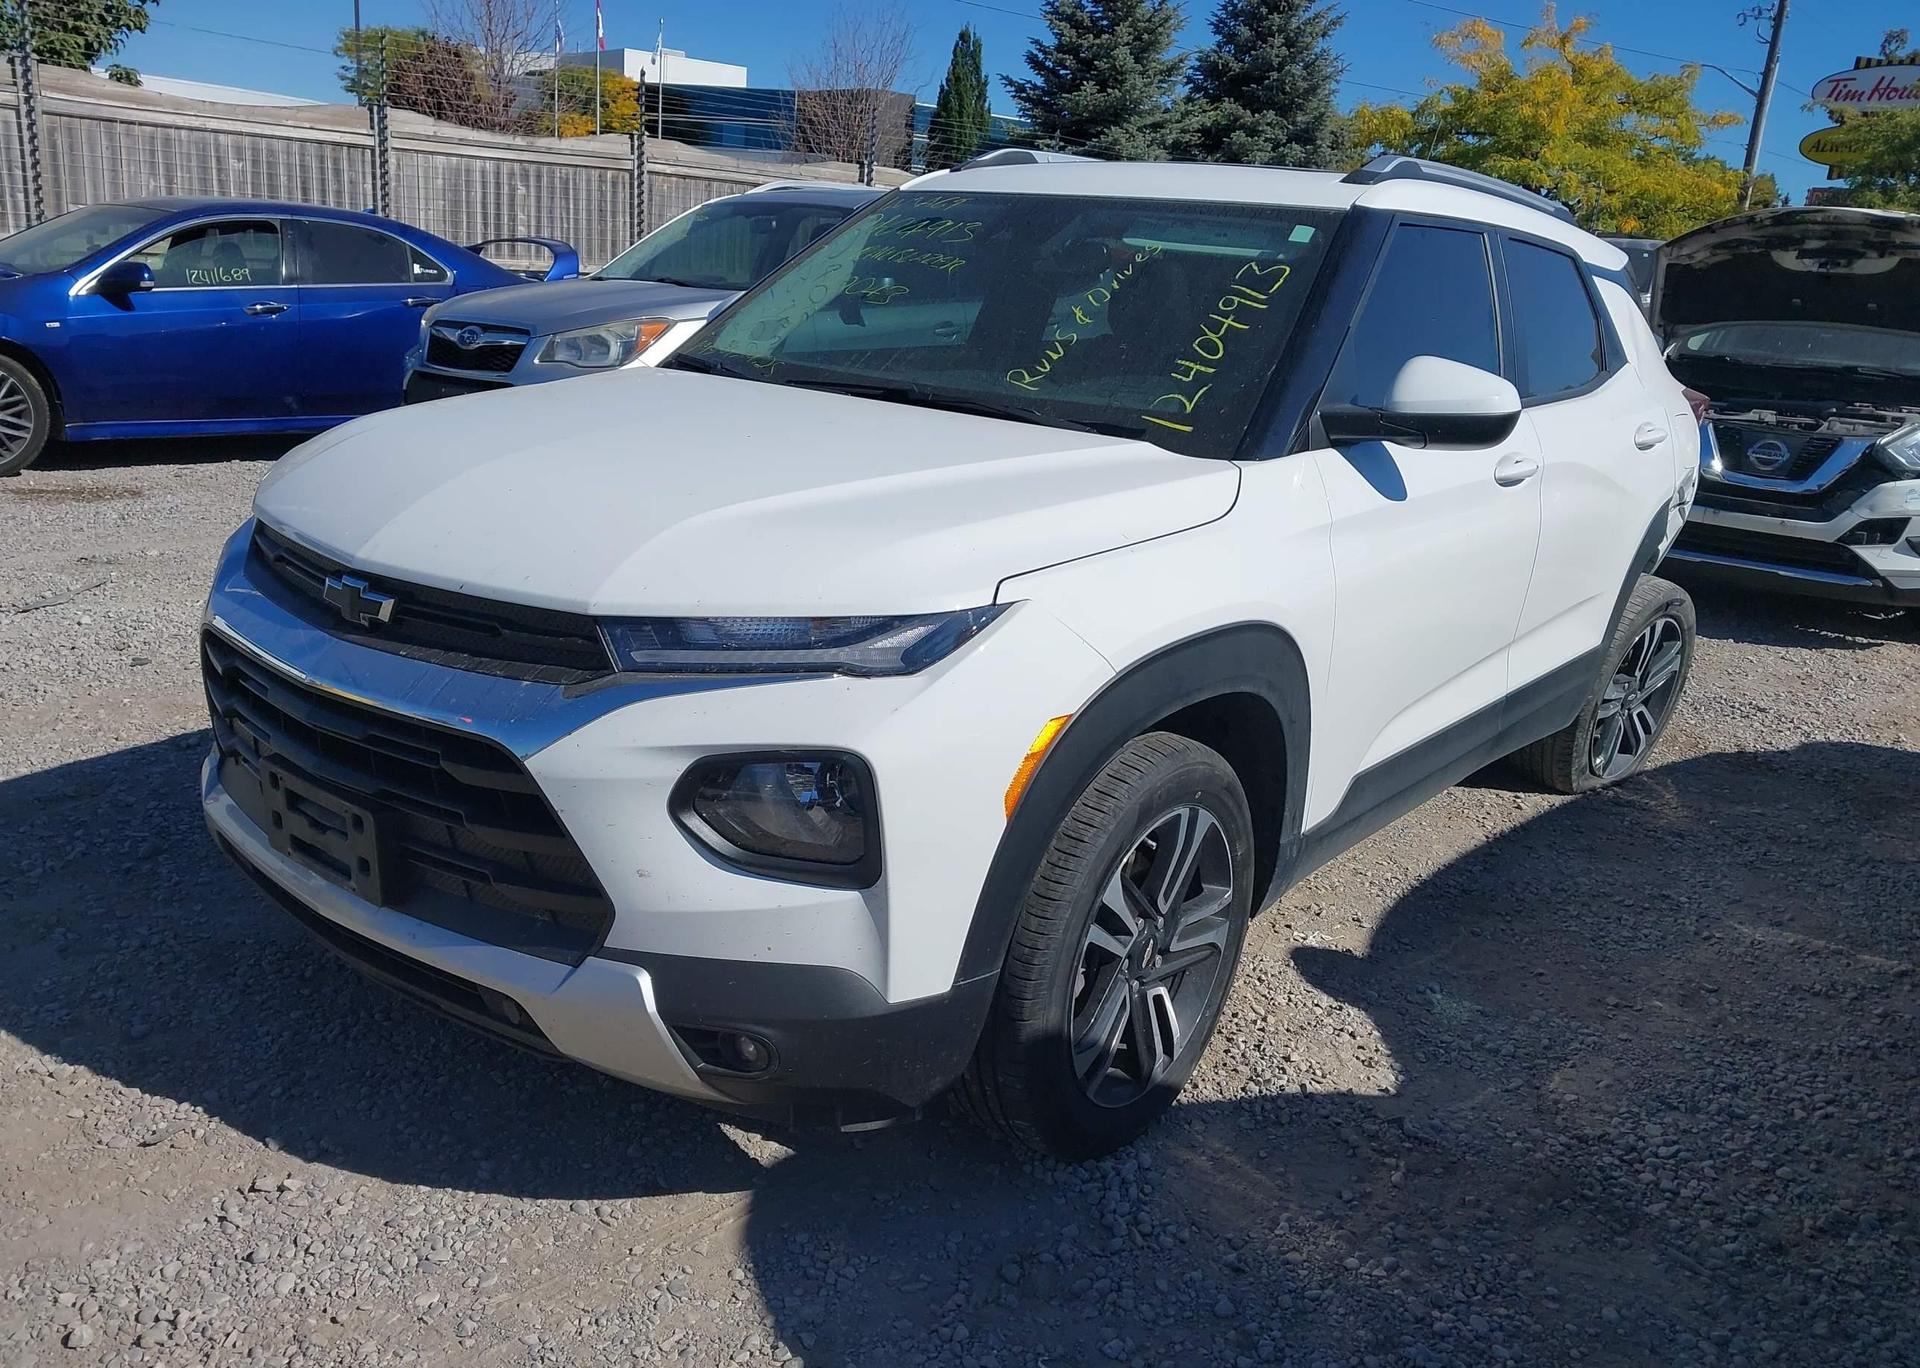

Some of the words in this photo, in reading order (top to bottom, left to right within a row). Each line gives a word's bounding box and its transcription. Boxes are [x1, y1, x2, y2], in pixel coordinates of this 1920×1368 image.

[1824, 77, 1865, 102] Tim
[185, 267, 252, 286] 12411689
[1083, 244, 1162, 307] Drives
[1141, 261, 1291, 432] 12404913
[1751, 449, 1786, 461] NISSAN
